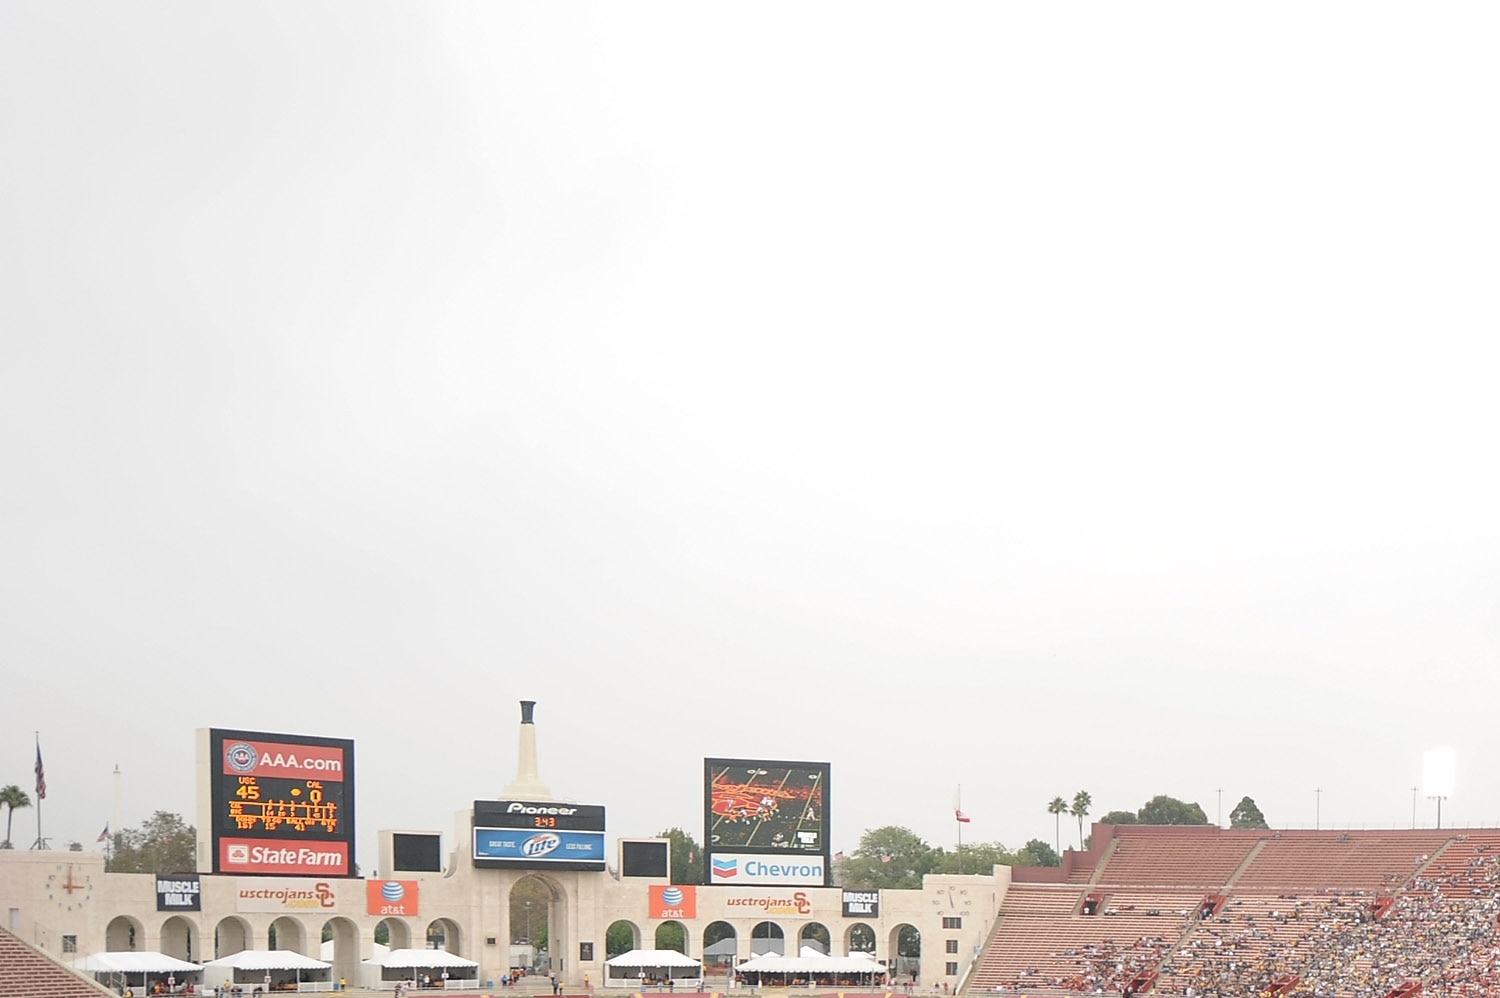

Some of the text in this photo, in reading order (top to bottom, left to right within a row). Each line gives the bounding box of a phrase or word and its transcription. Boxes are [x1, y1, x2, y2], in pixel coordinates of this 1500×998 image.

[260, 752, 341, 771] AAA.com
[239, 777, 256, 785] USC
[307, 781, 323, 789] CAL
[236, 786, 260, 800] 45
[507, 803, 578, 815] Pioneer
[528, 839, 557, 855] Lite
[745, 861, 822, 877] Chevron
[157, 881, 199, 894] MUSCLE
[165, 893, 193, 906] MILK
[239, 888, 313, 904] usctrojans
[843, 892, 878, 903] MUSCLE
[380, 905, 405, 915] at&t
[727, 898, 792, 911] usctrojans
[849, 903, 873, 913] MILK
[661, 908, 684, 918] at&t
